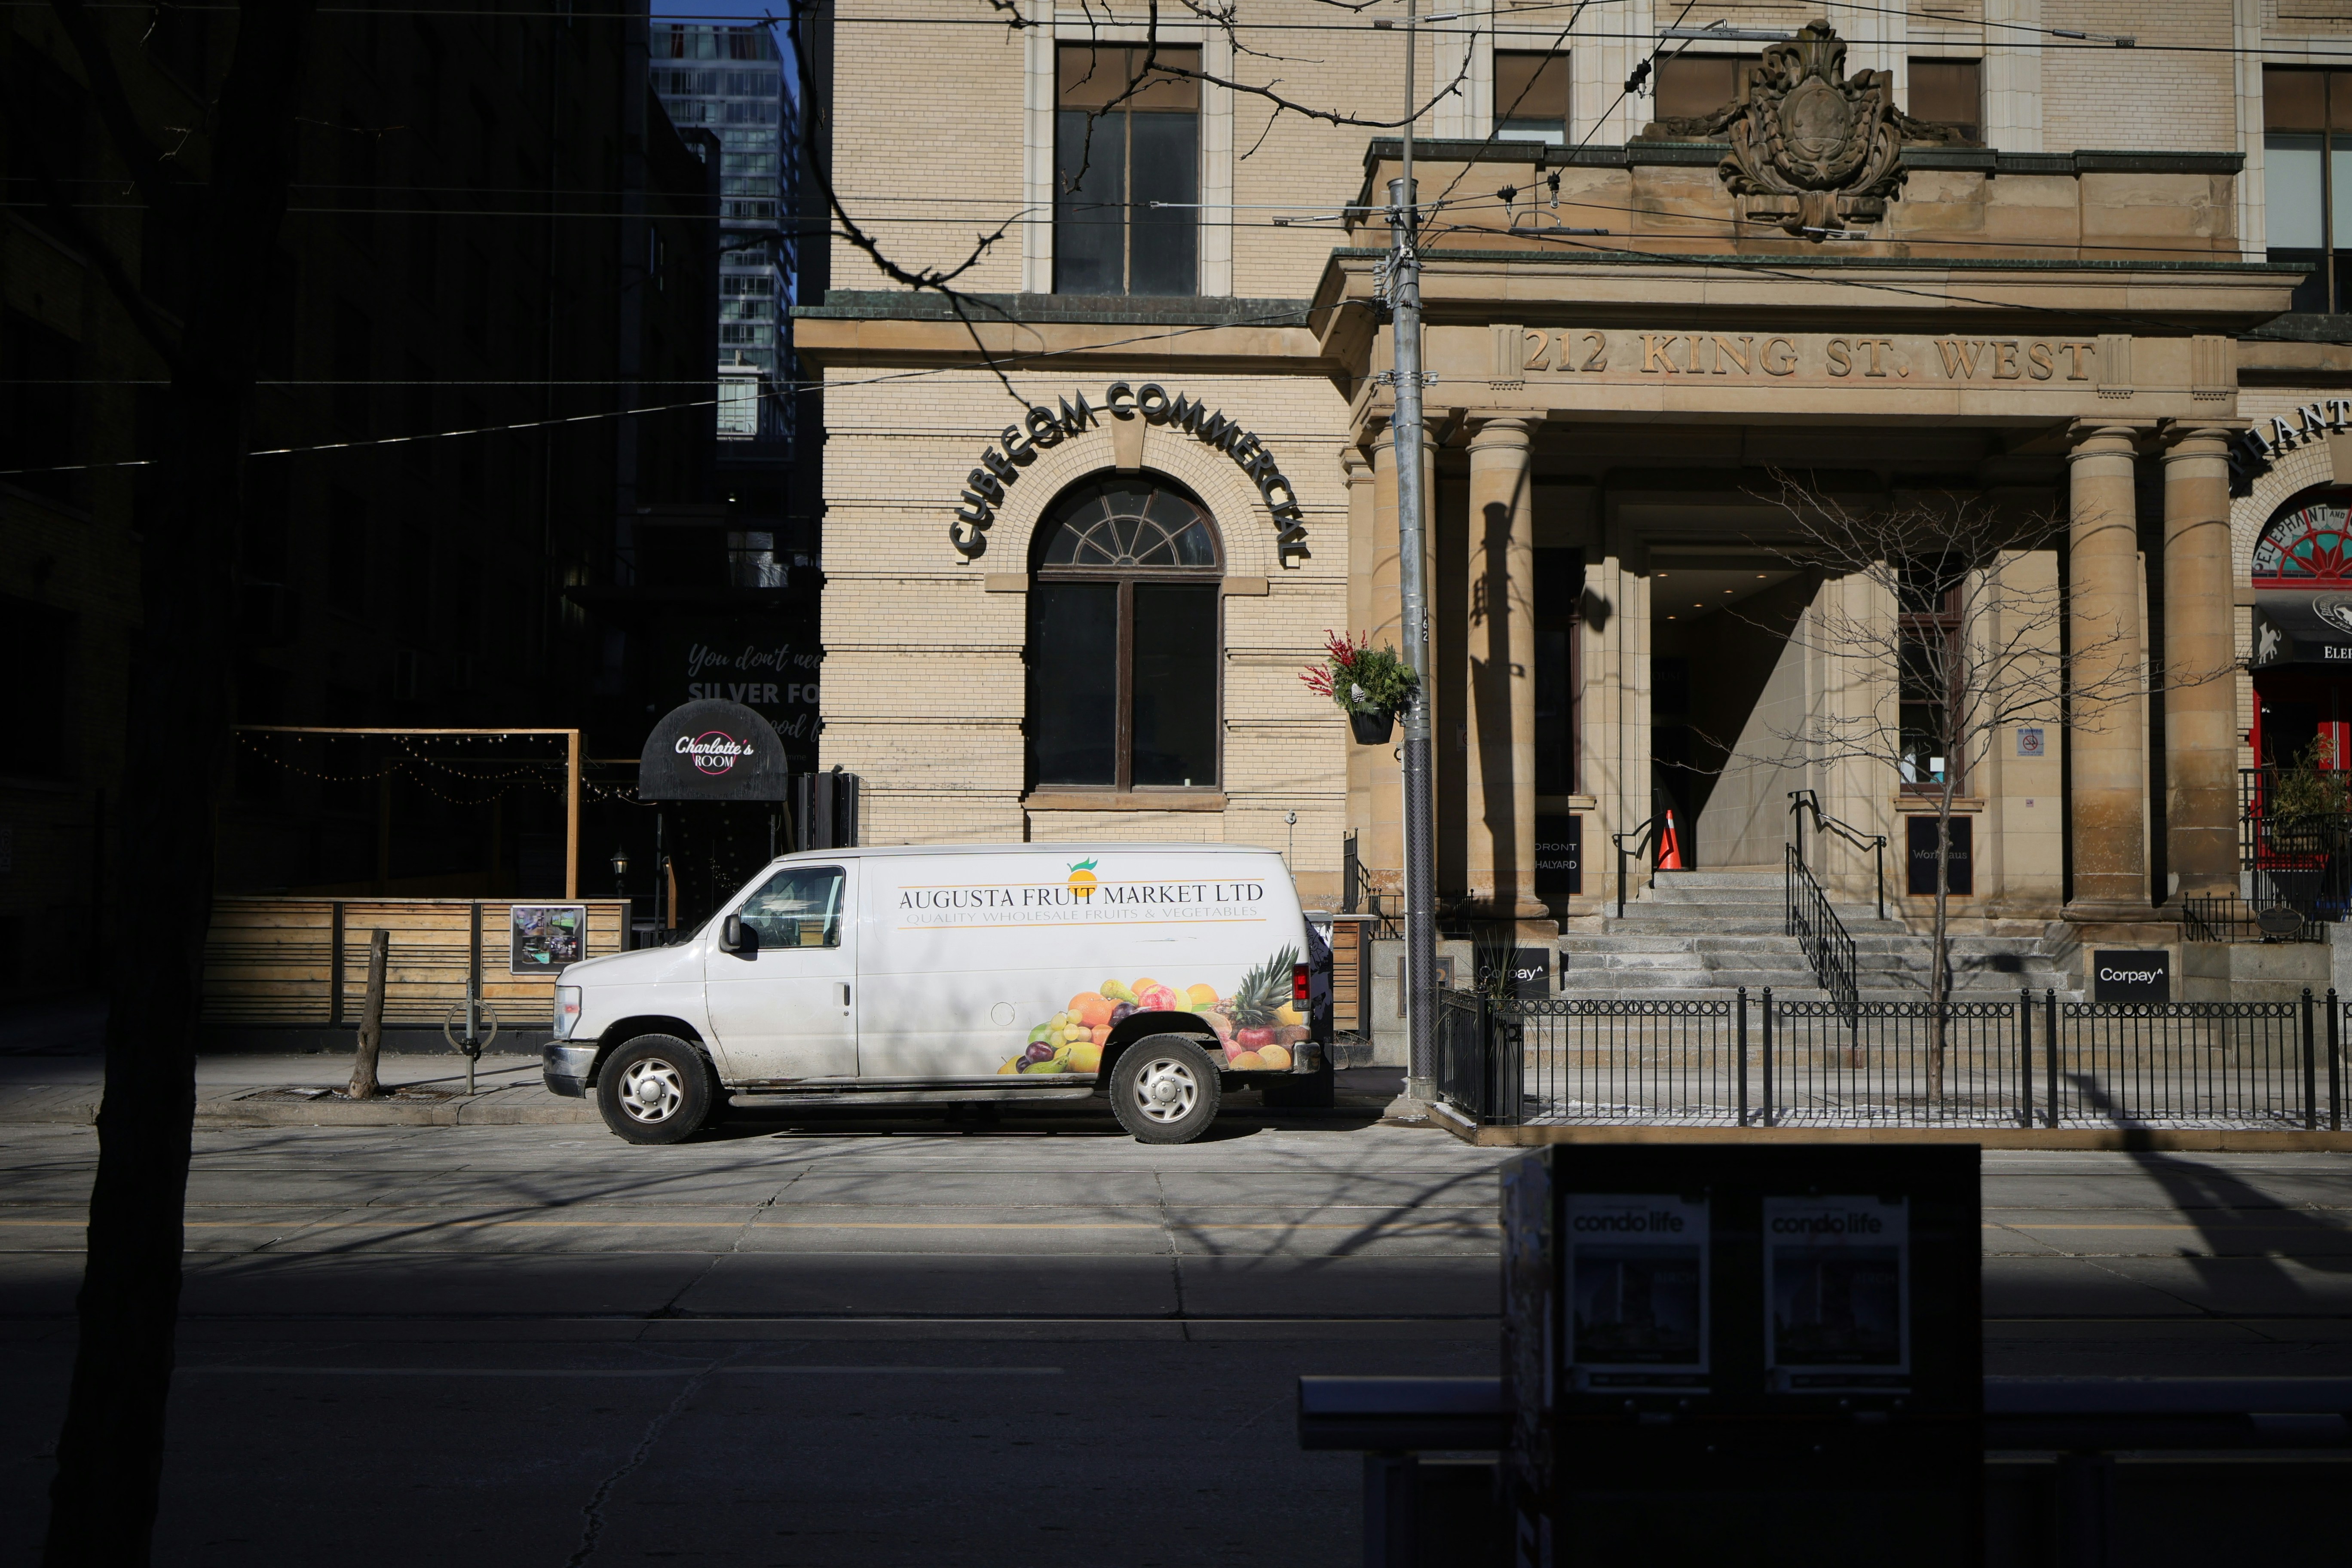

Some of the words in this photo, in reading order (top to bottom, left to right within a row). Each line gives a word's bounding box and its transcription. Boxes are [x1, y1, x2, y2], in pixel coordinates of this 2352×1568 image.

[1523, 329, 1608, 373] 212
[1638, 334, 1798, 376] KING
[1825, 337, 1908, 377] ST.
[1934, 339, 2096, 381] WEST
[2228, 400, 2351, 476] PHANT
[949, 388, 1100, 550] CUBECOM
[1106, 382, 1307, 560] COMMERCIAL
[2257, 507, 2328, 563] ELEPHANT
[2329, 510, 2346, 519] AND
[688, 643, 730, 677] You
[735, 643, 790, 671] don't
[688, 682, 780, 704] SILVER
[769, 713, 808, 738] ood
[675, 735, 754, 756] Charlotte's
[695, 755, 734, 767] ROOM
[1535, 860, 1577, 869] HALYARD
[1912, 849, 1967, 859] Woraus
[899, 888, 1015, 909] AUGUSTA
[1022, 887, 1096, 906] FRUIT
[1103, 884, 1207, 905] MARKET
[1215, 883, 1264, 902] LTD
[906, 913, 976, 925] QUALITY
[983, 910, 1078, 922] WHOLESALE
[1085, 909, 1138, 919] FRUITS
[1145, 908, 1155, 918] &
[1162, 906, 1258, 917] VEGETABLES
[1479, 965, 1536, 981] Copay
[1654, 1271, 1696, 1283] BIRCH
